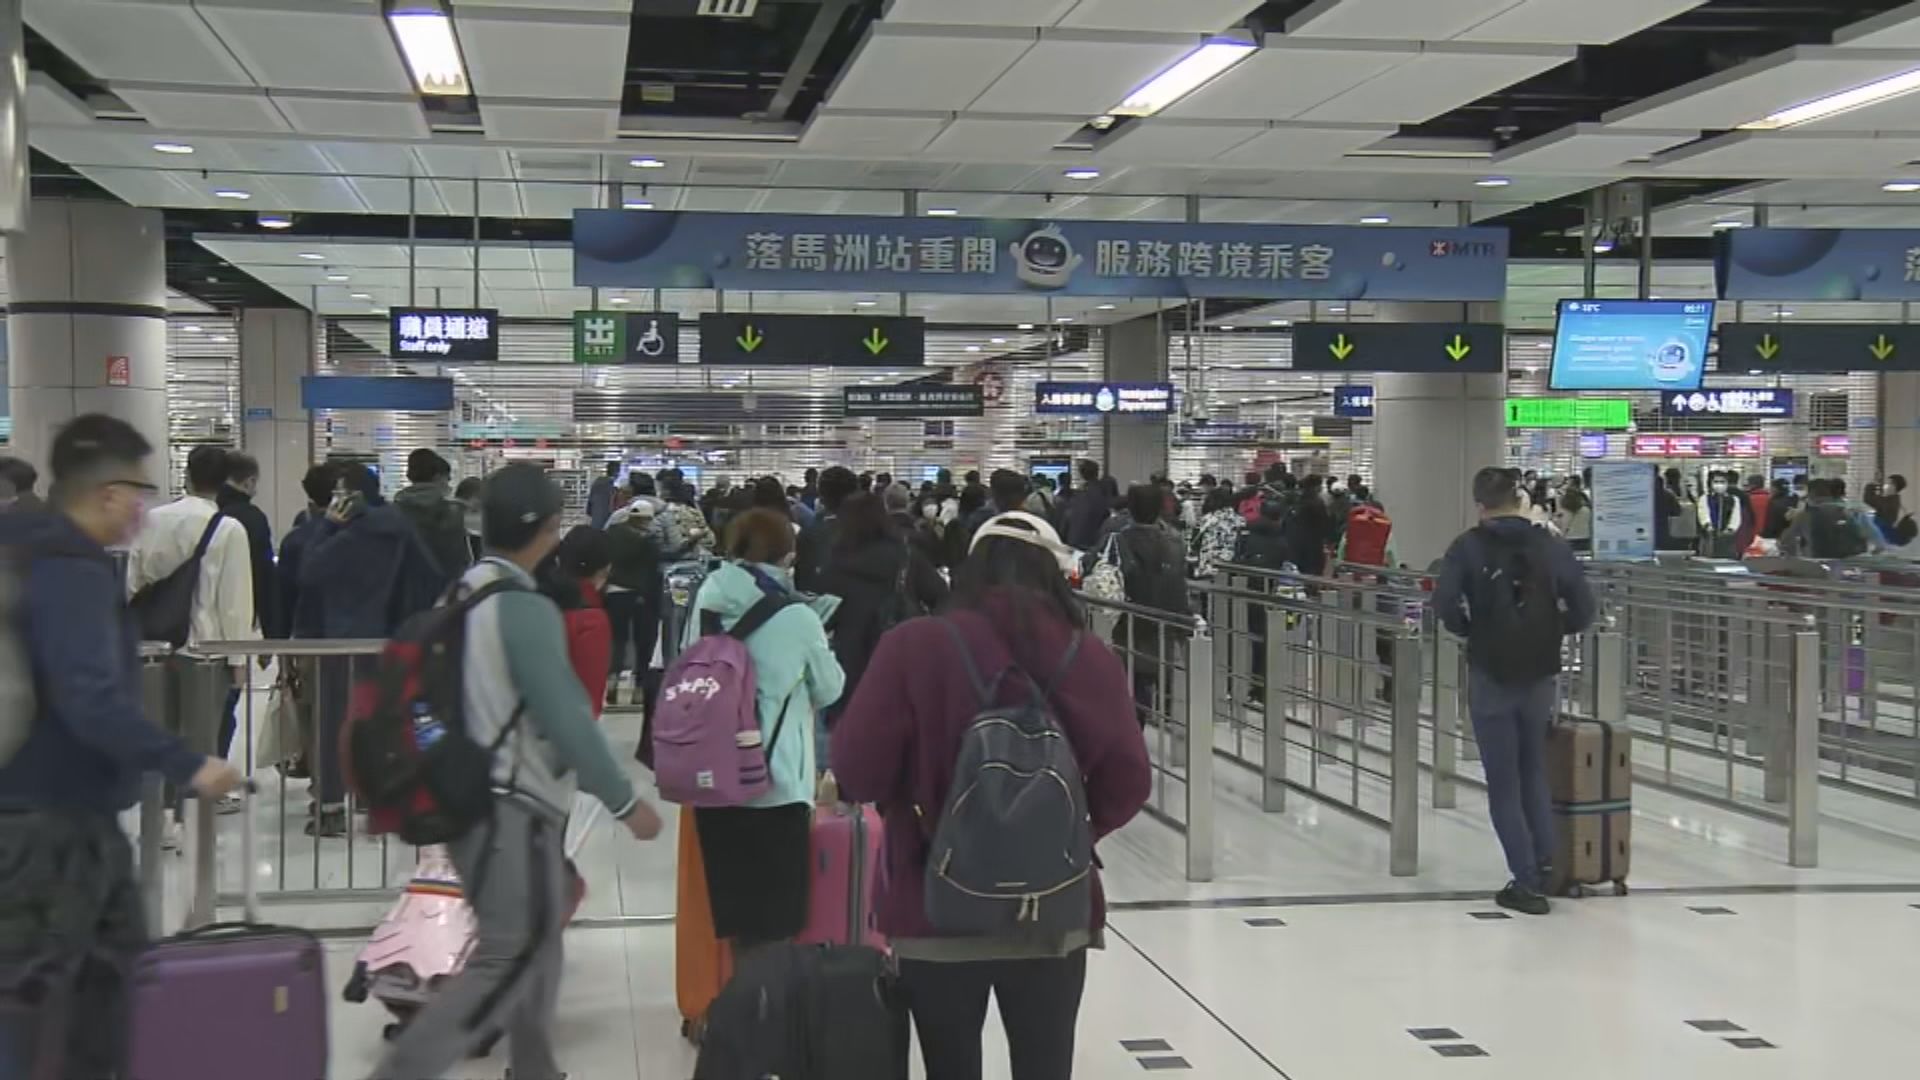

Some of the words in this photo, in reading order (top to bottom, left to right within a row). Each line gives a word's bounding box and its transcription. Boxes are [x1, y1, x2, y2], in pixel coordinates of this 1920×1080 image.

[746, 232, 997, 274] 落馬洲站重開
[1095, 239, 1335, 281] 服務跨境乘客
[1453, 242, 1496, 257] MTR
[584, 318, 615, 344] 出
[399, 340, 425, 351] Staff
[426, 340, 452, 355] only
[584, 346, 614, 356] EXIT
